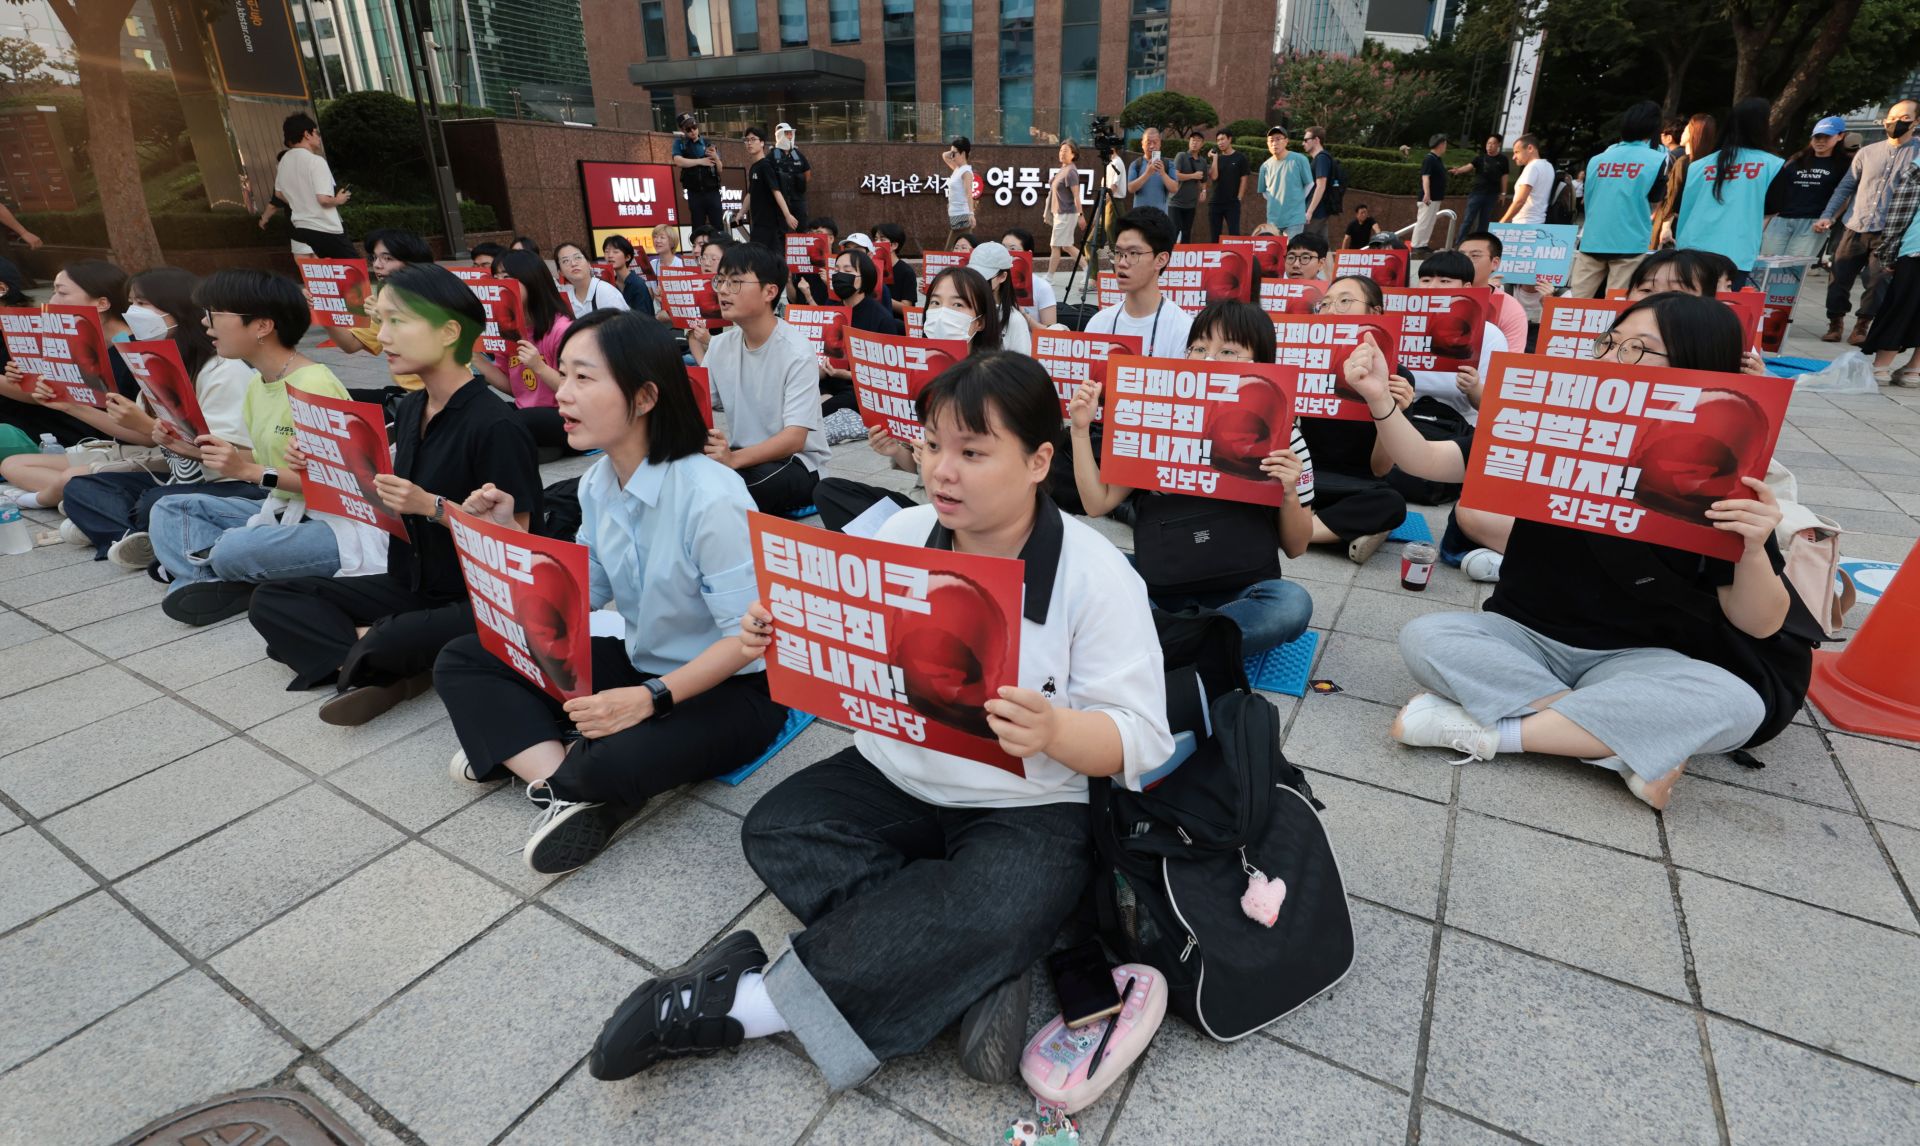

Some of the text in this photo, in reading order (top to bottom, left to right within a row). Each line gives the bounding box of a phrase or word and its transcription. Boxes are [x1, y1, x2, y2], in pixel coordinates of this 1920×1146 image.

[860, 174, 922, 197] 서점다운
[986, 167, 1095, 206] 영풍고
[1597, 162, 1645, 180] 진보당
[611, 177, 656, 202] MUJI
[618, 204, 653, 216] 無印良品
[302, 263, 347, 281] 딥페이크
[1168, 251, 1222, 268] 페이크
[1338, 253, 1386, 267] 딥페이크
[307, 281, 340, 296] 성범죄
[312, 296, 348, 312] 끝내자!
[1382, 294, 1452, 314] 페이크
[331, 313, 355, 326] 진보당
[788, 309, 835, 325] 딥페이크
[482, 338, 507, 353] 진보당
[850, 336, 929, 371] 딥페이크
[1037, 336, 1110, 361] 딥페이크
[66, 385, 98, 404] 진보당
[854, 362, 909, 395] 성범죄
[1115, 366, 1241, 402] 딥페이크
[1499, 366, 1703, 424] 딥페이크
[858, 386, 919, 422] 끝내자!
[1113, 398, 1205, 433] 성범죄
[1294, 396, 1342, 417] 진보당
[1112, 429, 1213, 466] 끝내자!
[1491, 407, 1638, 458] 성범죄
[306, 457, 365, 498] 끝내자!
[1156, 466, 1220, 494] 진보당
[1483, 445, 1643, 500] 끝내자!
[338, 494, 378, 525] 진보당
[1547, 494, 1648, 534] 진보당
[450, 514, 535, 586] 딥페이크
[461, 554, 516, 616] 성범죄
[761, 531, 932, 615] 딥페이크
[469, 589, 532, 657] 끝내자!
[769, 582, 888, 654] 성범죄
[504, 642, 547, 689] 진보당
[774, 627, 910, 705] 끝내자!
[839, 691, 927, 742] 진보당
